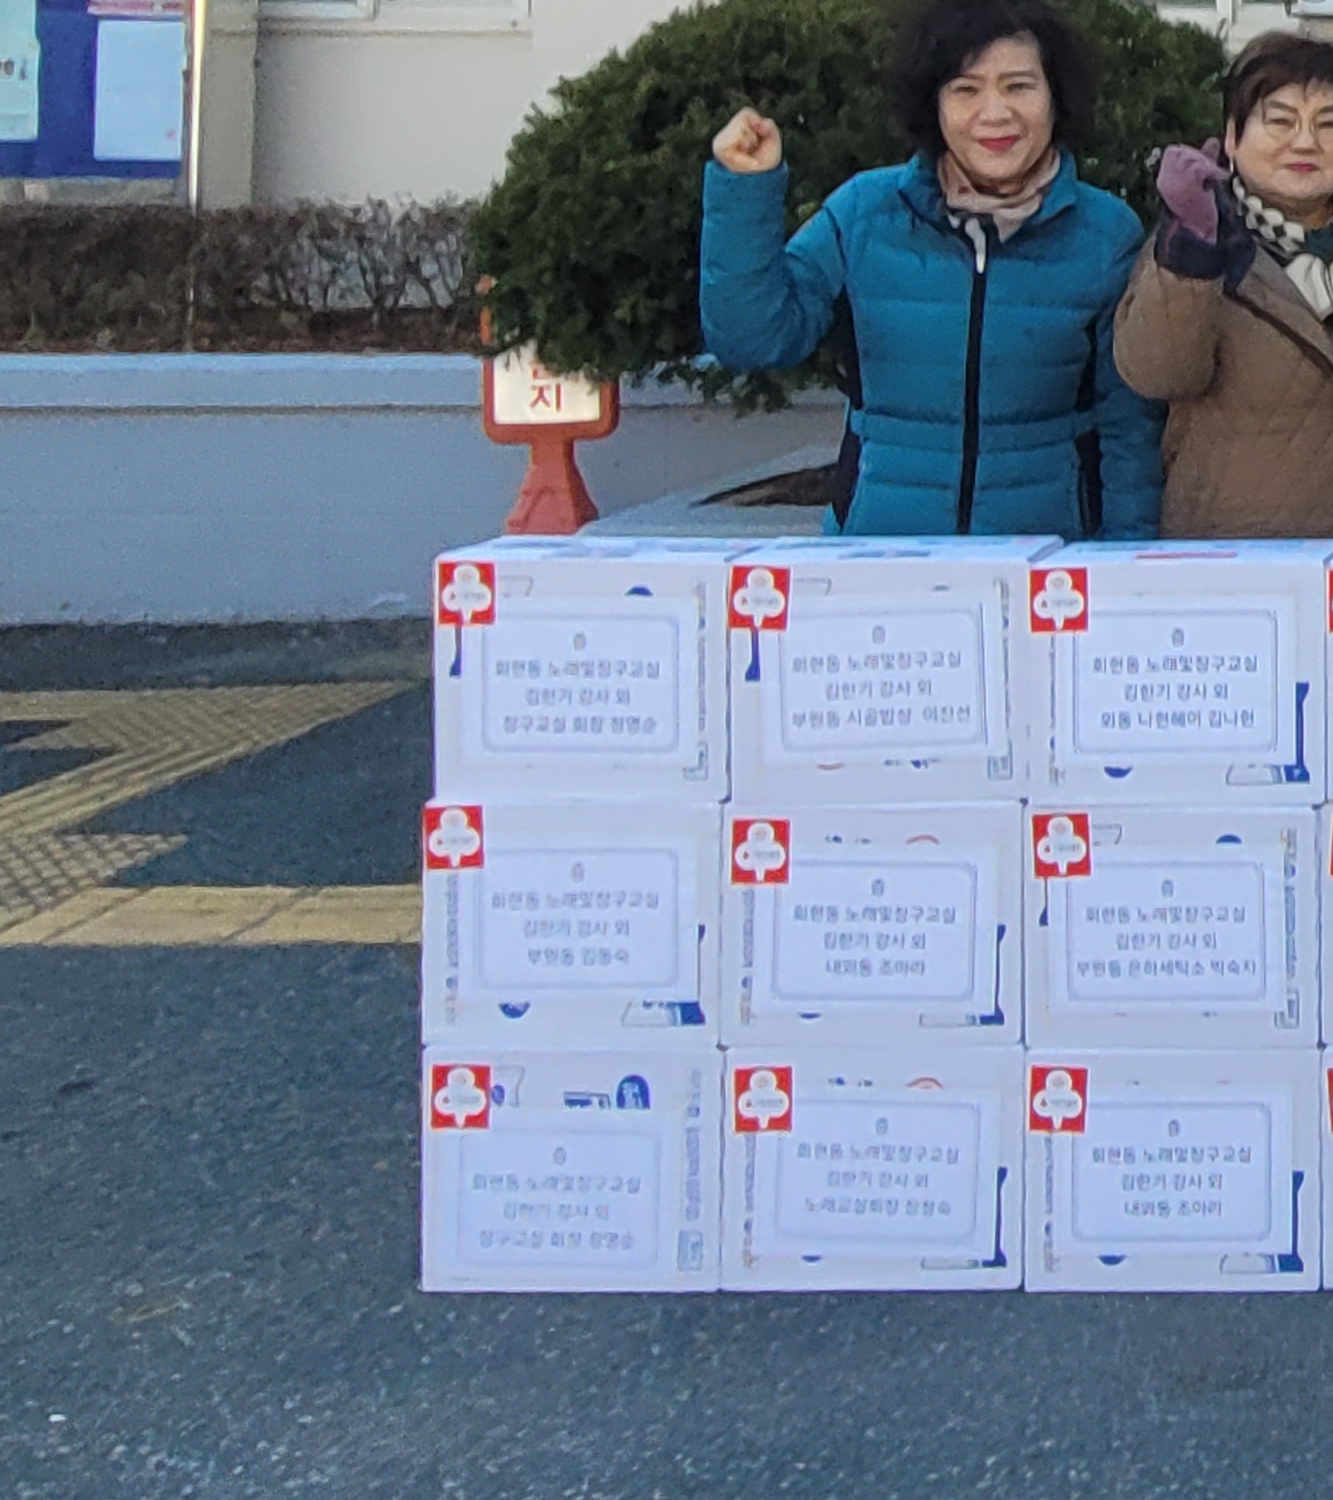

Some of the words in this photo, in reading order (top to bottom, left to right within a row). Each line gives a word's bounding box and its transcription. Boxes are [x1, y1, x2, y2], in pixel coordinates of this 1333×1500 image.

[1093, 655, 1139, 675] 회현동
[1125, 684, 1170, 702] 김한기
[1177, 683, 1207, 701] 강사
[1214, 683, 1228, 699] 외
